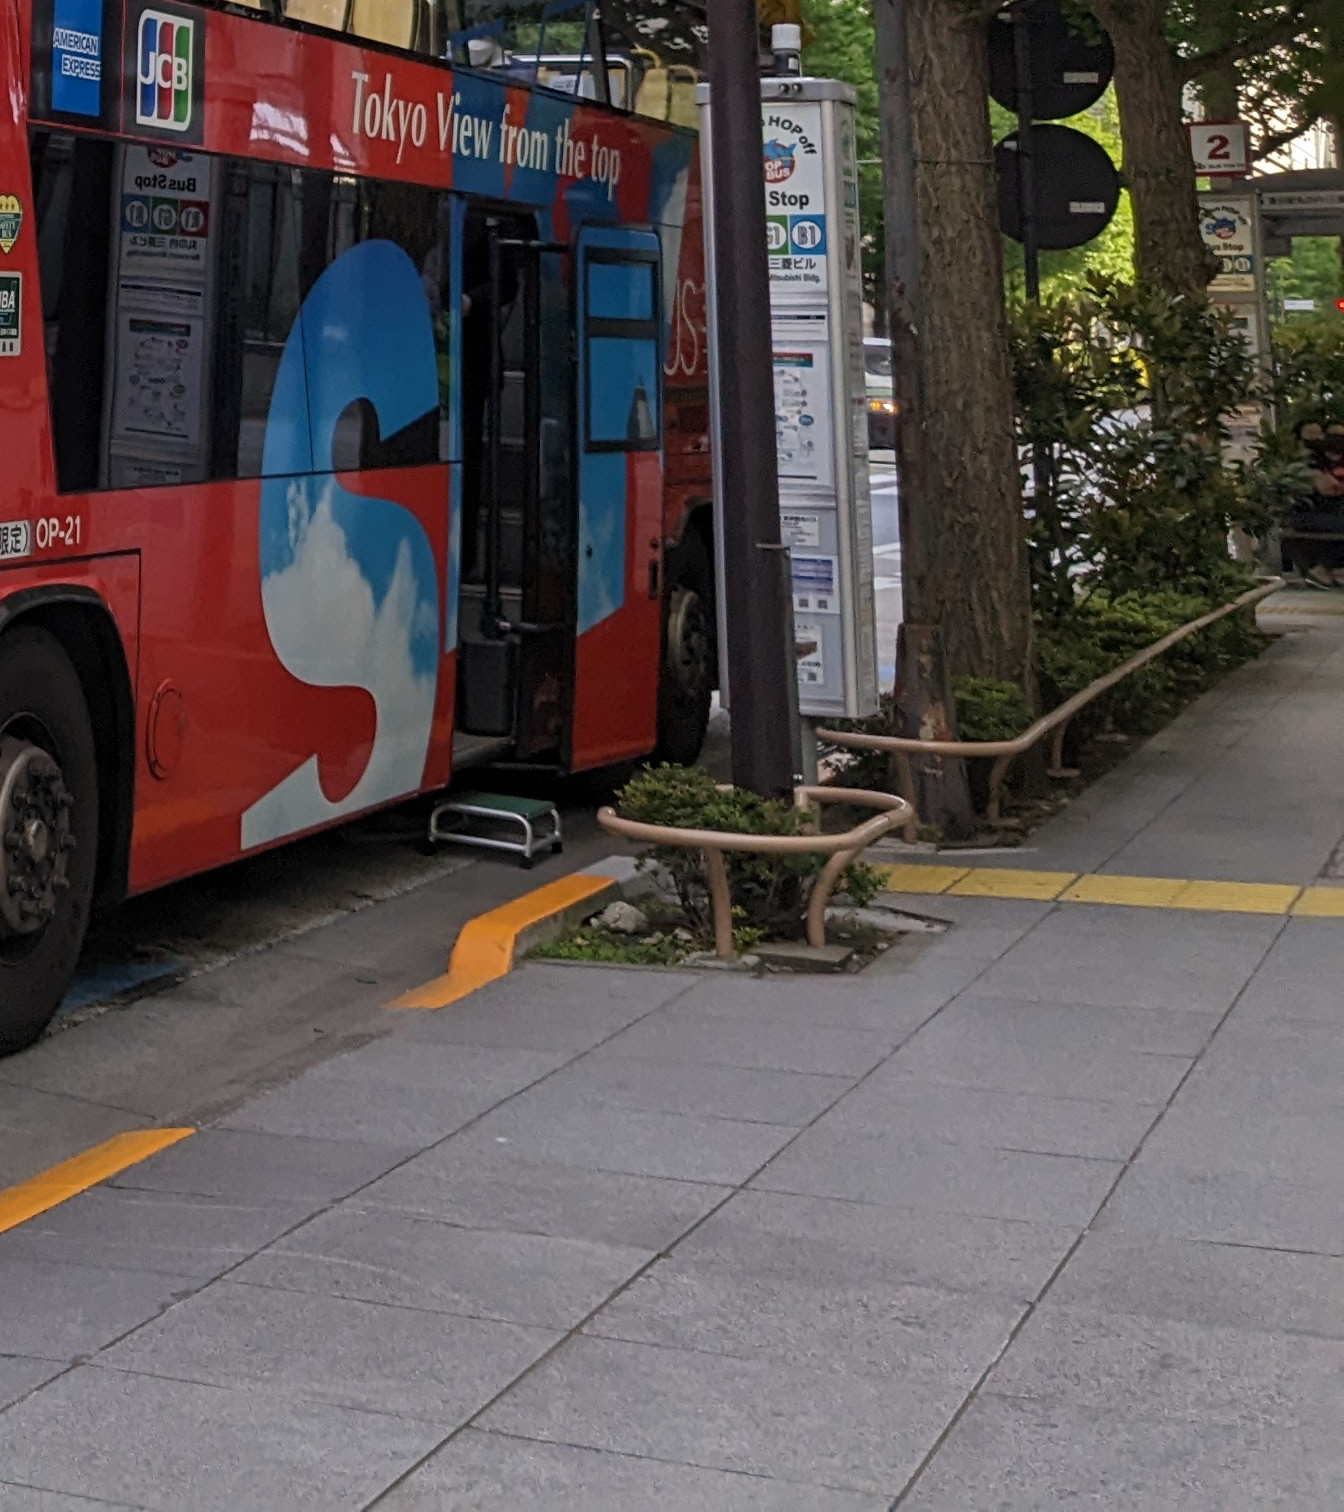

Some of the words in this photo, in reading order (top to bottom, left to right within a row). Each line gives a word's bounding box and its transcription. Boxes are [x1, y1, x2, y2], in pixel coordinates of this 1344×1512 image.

[53, 27, 99, 56] AMERICAN
[61, 54, 102, 82] EXPRESS
[139, 51, 188, 91] JCB
[351, 71, 427, 165] Tokyo
[437, 91, 494, 161] View
[499, 103, 548, 172] from
[555, 118, 585, 180] the
[591, 138, 621, 202] top
[768, 115, 803, 135] HOP
[1206, 134, 1230, 160] 2
[768, 190, 810, 210] Stop
[35, 514, 81, 548] OP-21
